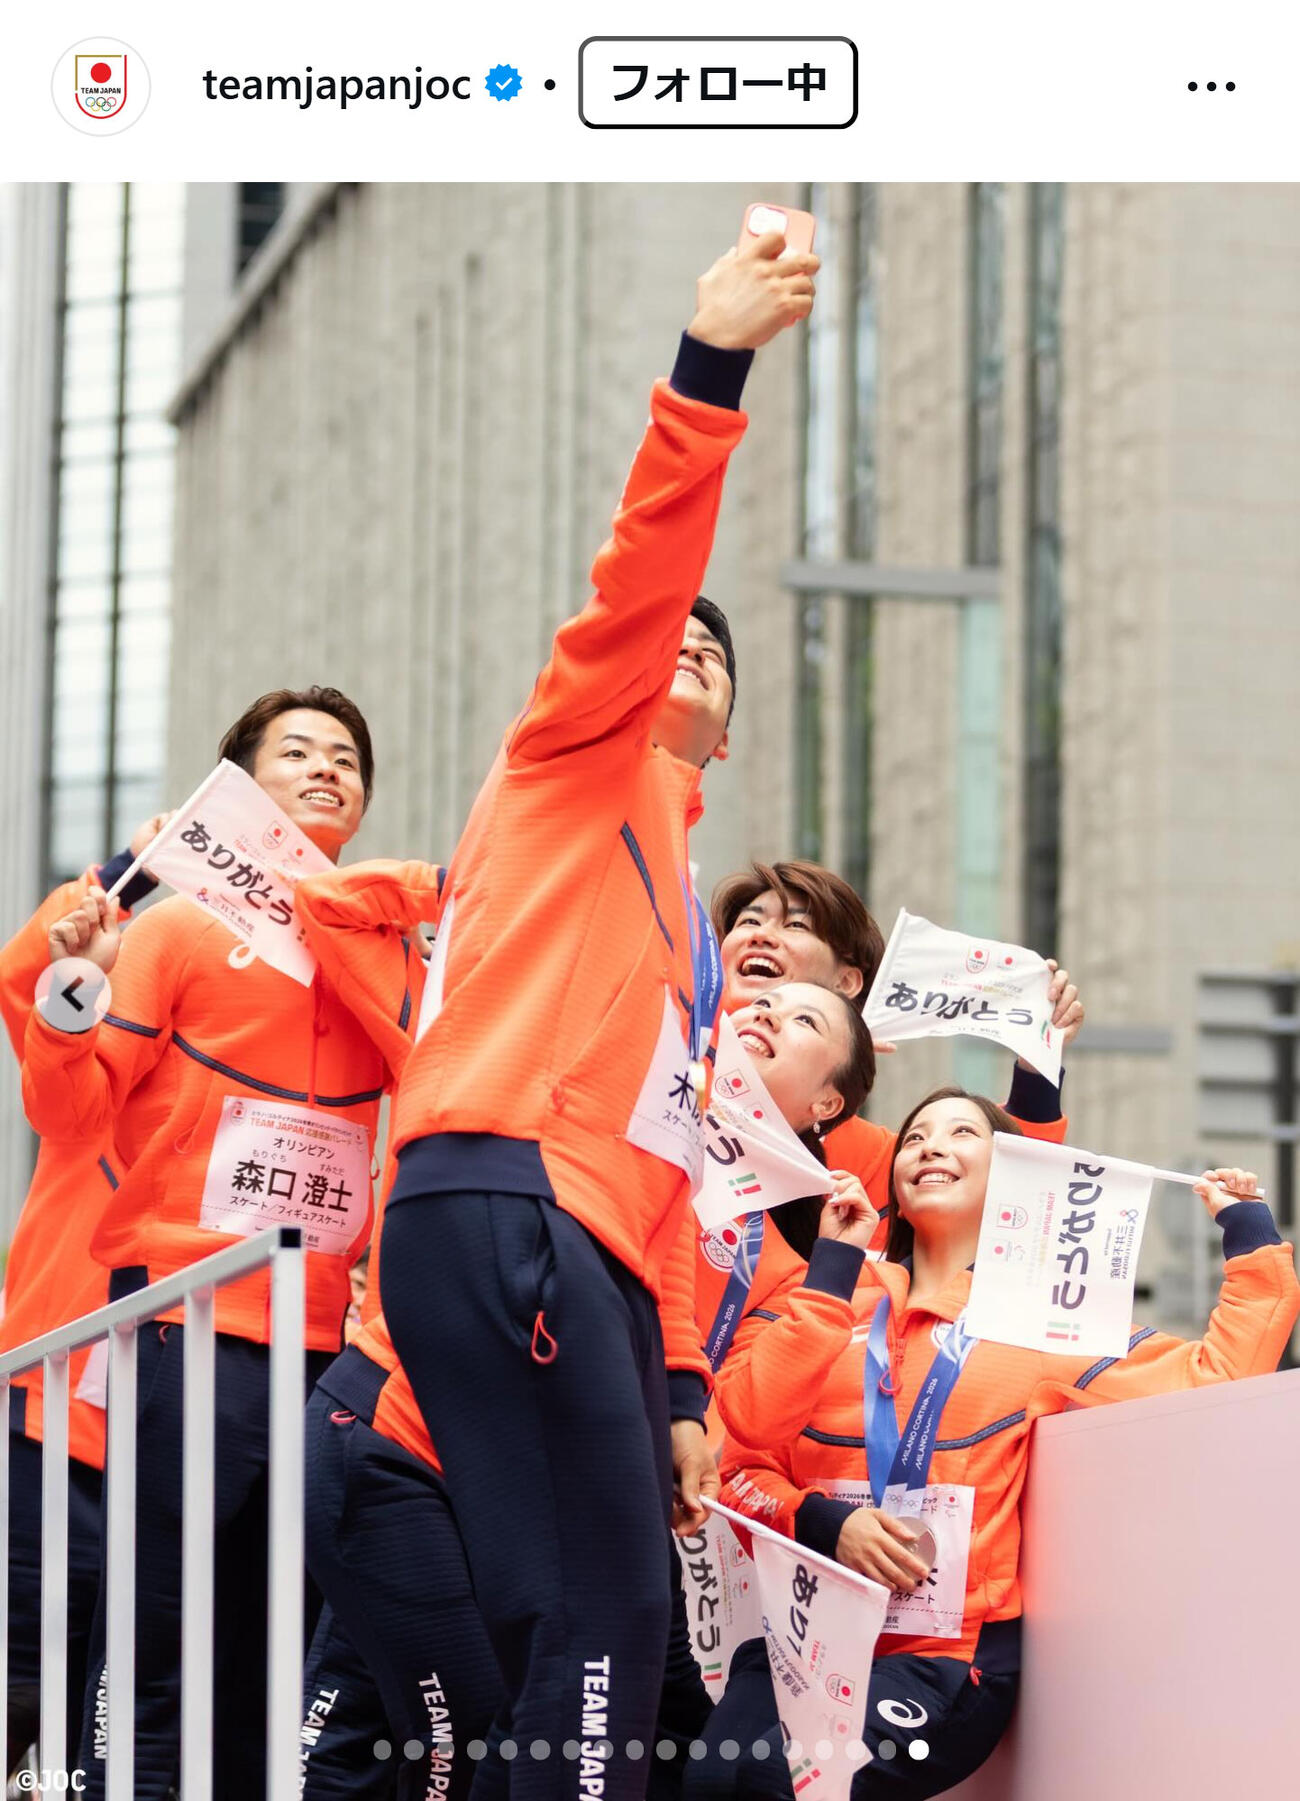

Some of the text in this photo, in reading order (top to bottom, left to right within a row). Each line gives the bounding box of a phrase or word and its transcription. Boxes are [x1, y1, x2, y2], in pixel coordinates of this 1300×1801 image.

[180, 820, 293, 926] ありがとう
[885, 982, 1033, 1026] ありがとう
[250, 1118, 275, 1129] TEAM
[276, 1122, 305, 1134] JAPAN
[272, 1137, 336, 1160] オリンピアン
[252, 1149, 287, 1163] もりぐち
[231, 1160, 353, 1213] 森口 澄士
[711, 1303, 736, 1358] CORTINA 2026
[901, 1430, 917, 1466] MILANO
[913, 1396, 930, 1432] CORTINA
[927, 1377, 938, 1395] 2026
[915, 1434, 928, 1471] MILANO
[300, 1689, 339, 1746] TEAM
[419, 1672, 454, 1743] TEAM
[582, 1655, 610, 1736] TEAM
